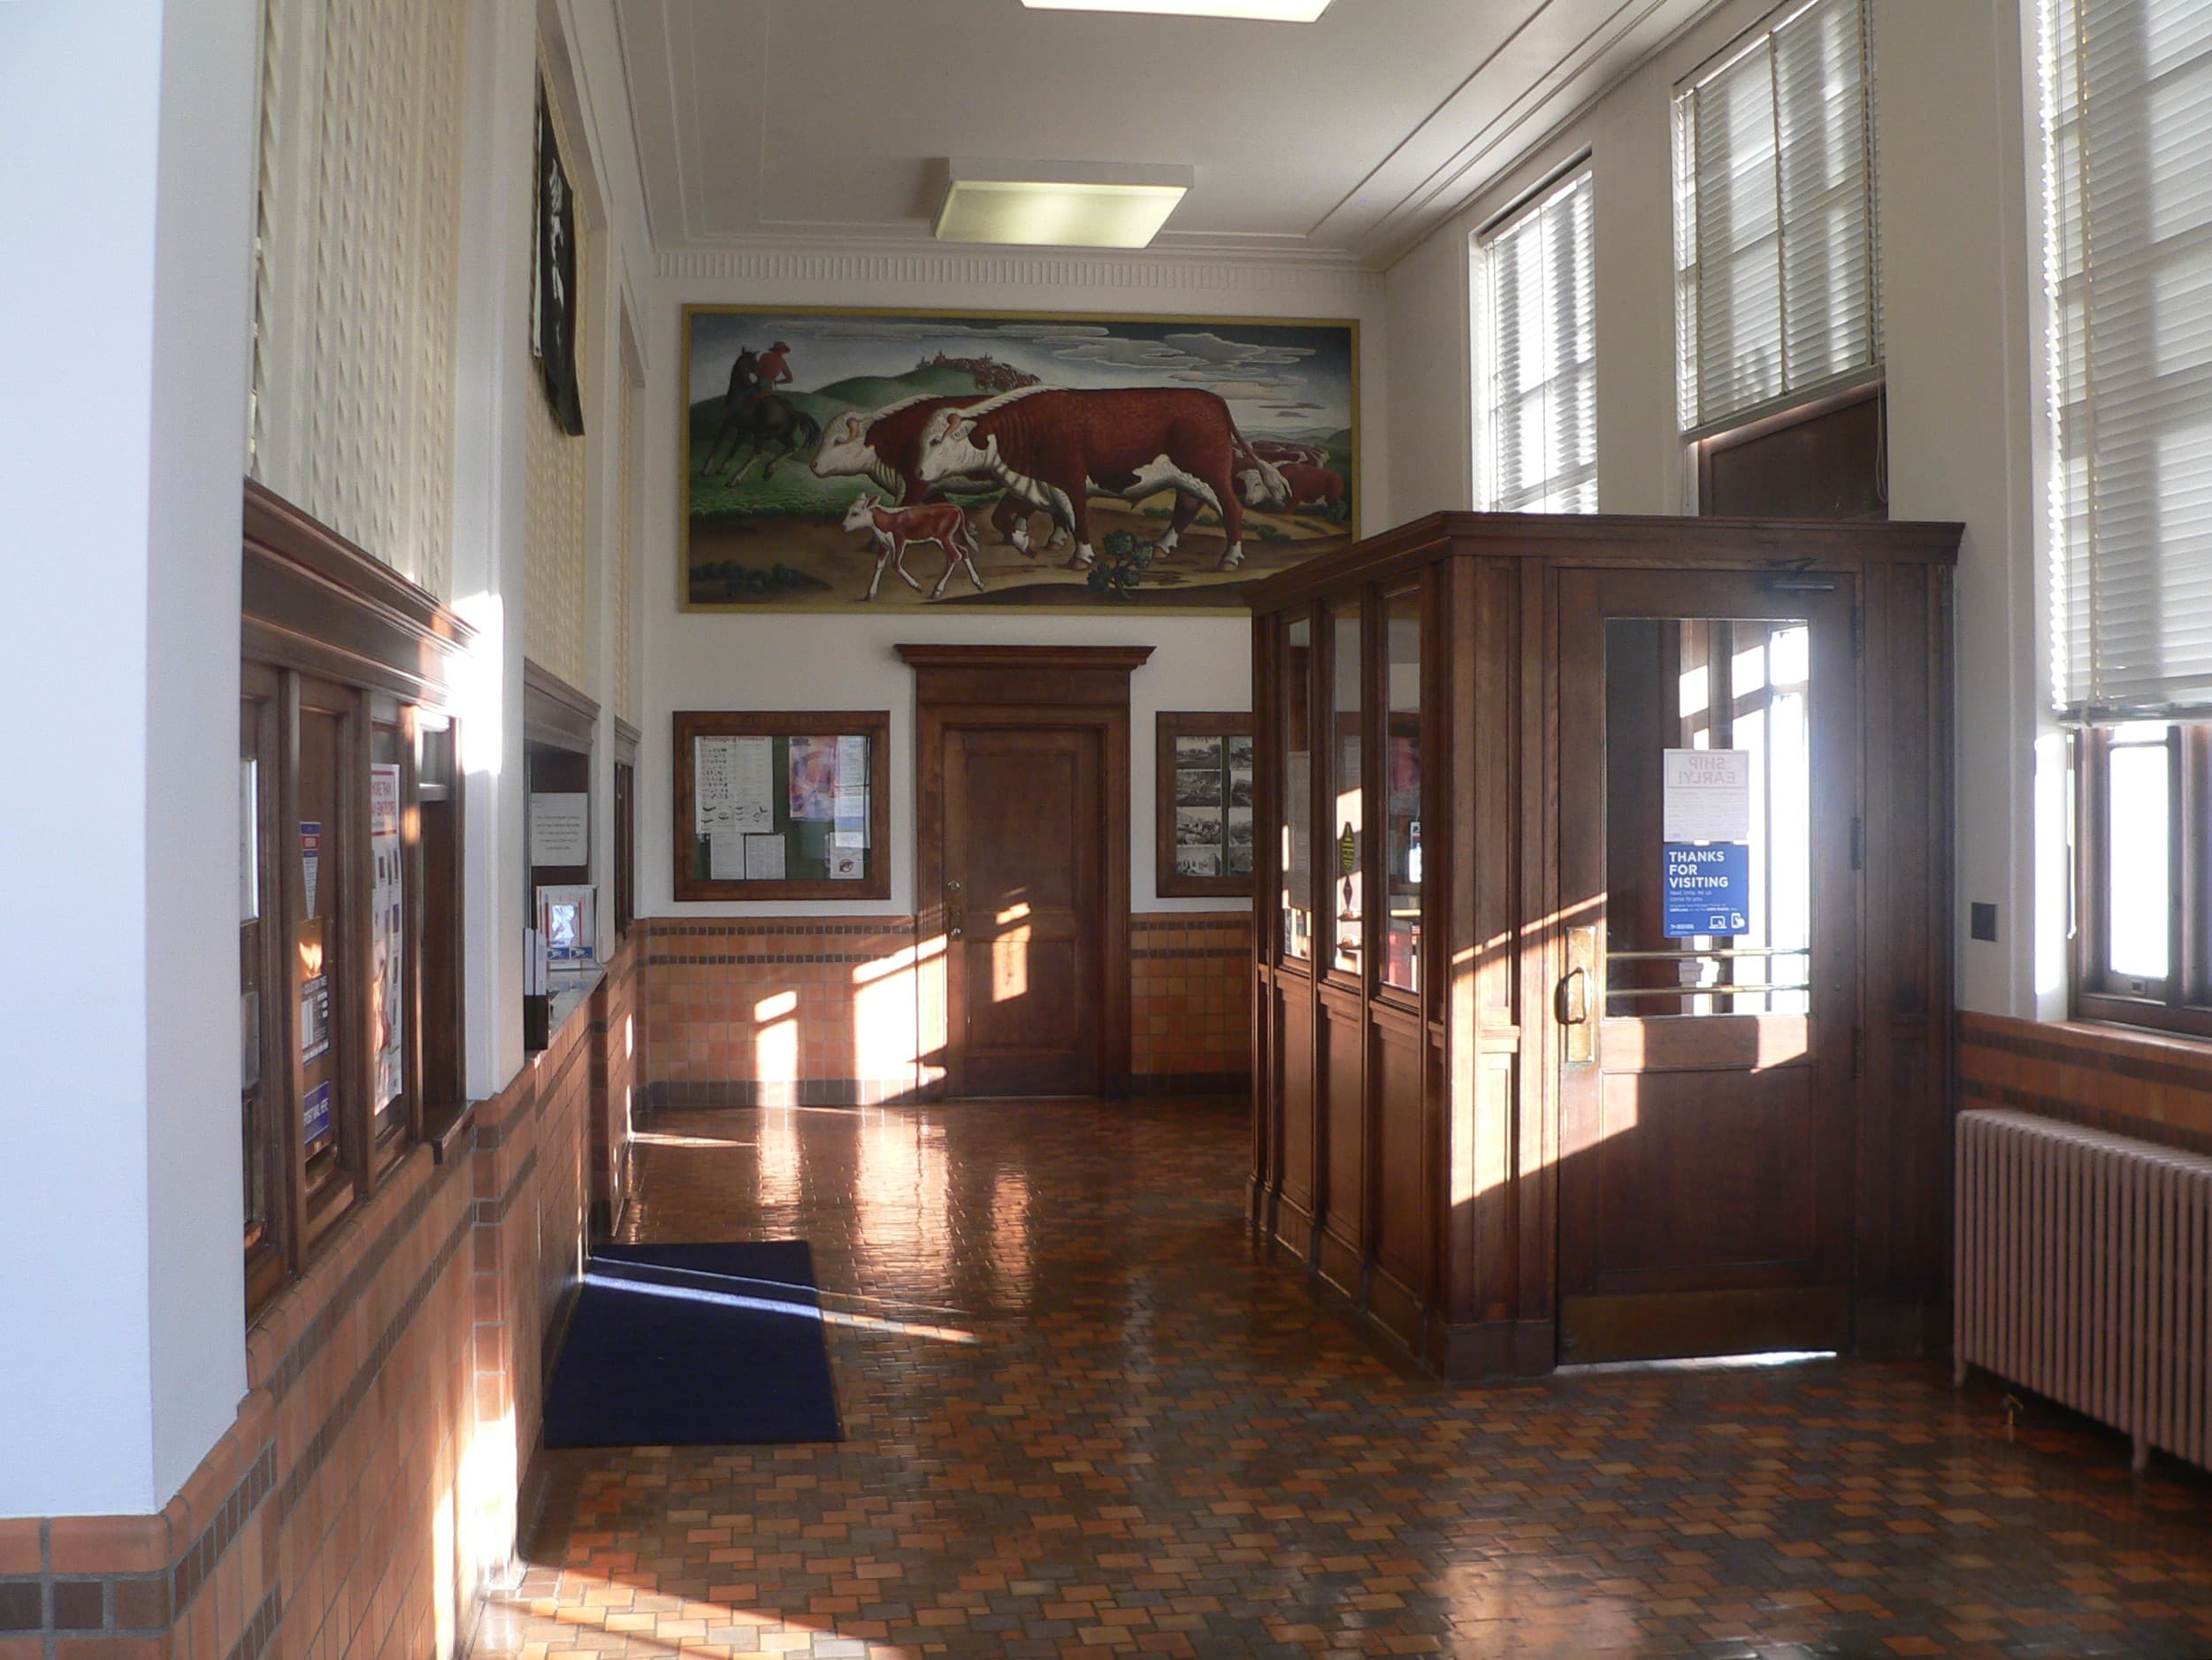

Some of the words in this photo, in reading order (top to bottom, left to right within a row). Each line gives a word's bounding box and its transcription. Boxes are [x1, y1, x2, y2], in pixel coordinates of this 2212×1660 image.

[1669, 851, 1725, 862] THANKS
[1669, 864, 1698, 876] FOR
[1669, 876, 1729, 888] VISITING
